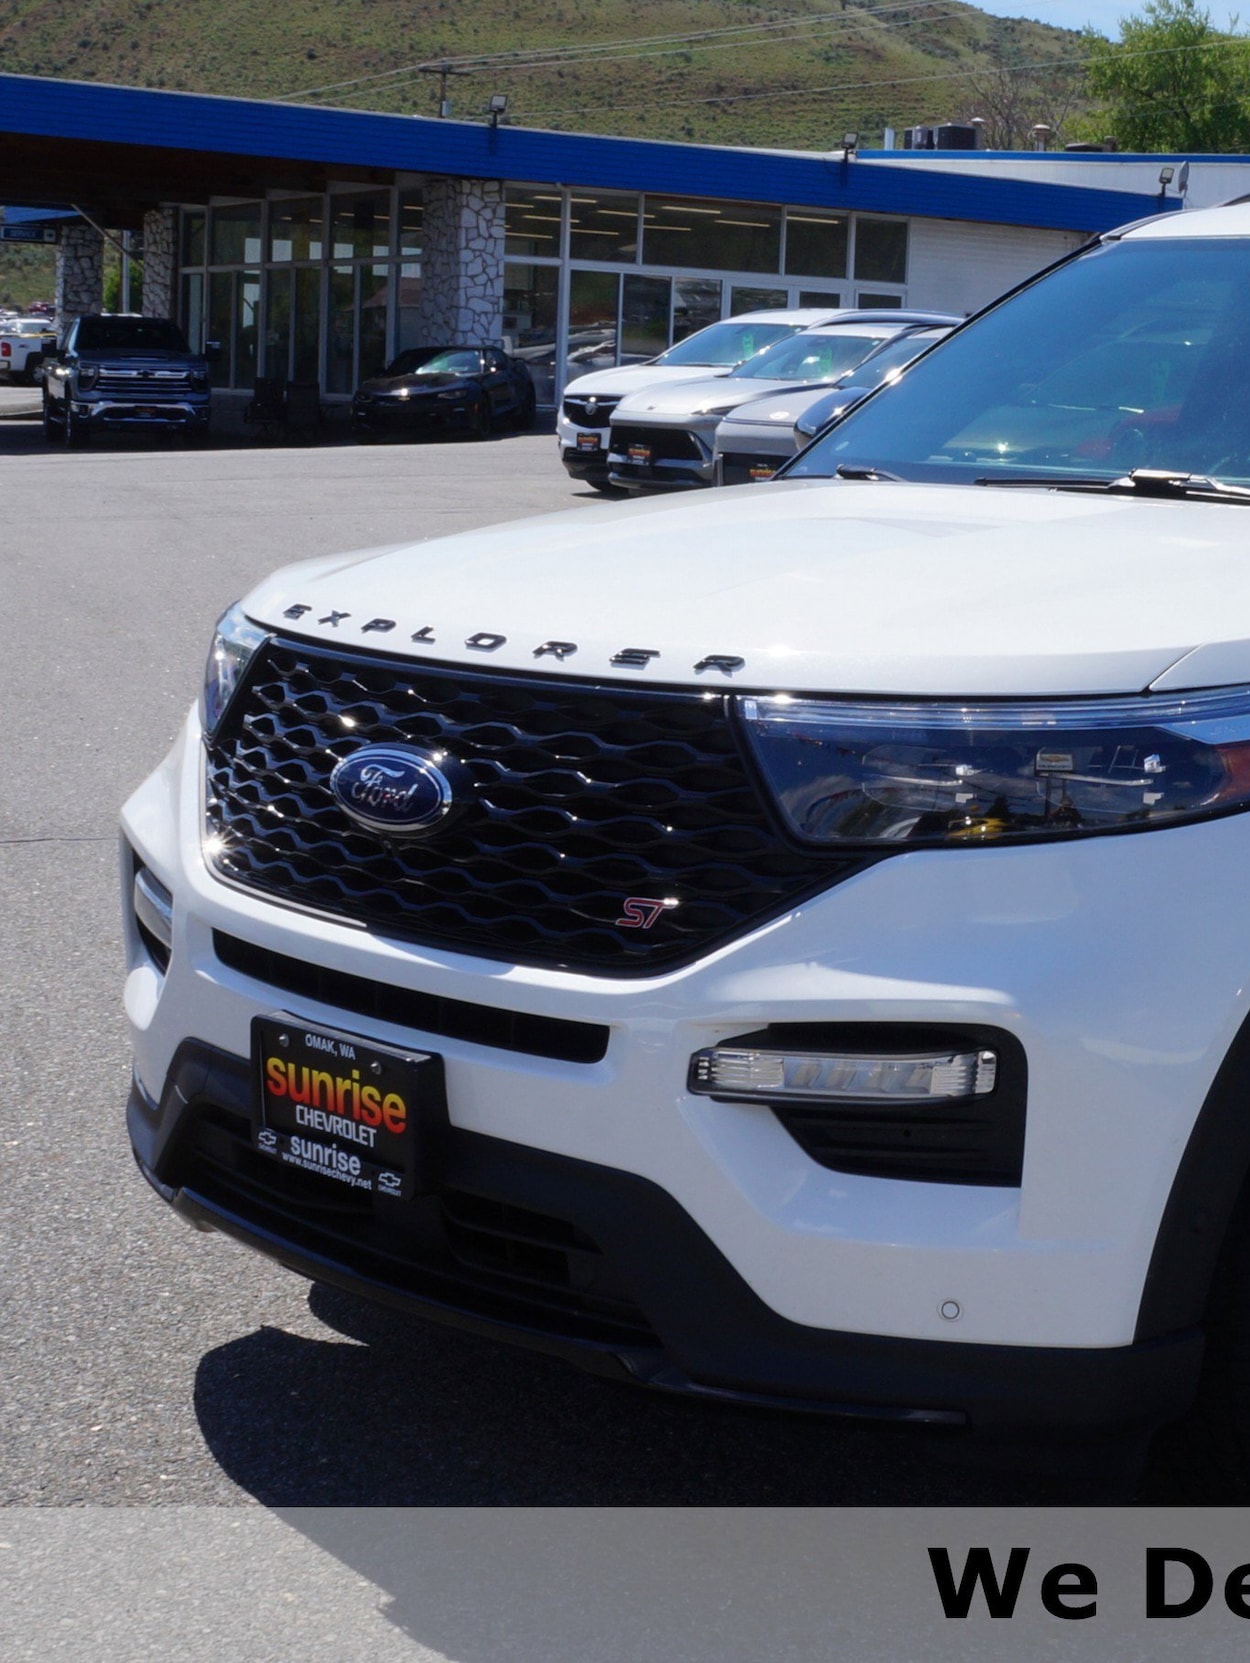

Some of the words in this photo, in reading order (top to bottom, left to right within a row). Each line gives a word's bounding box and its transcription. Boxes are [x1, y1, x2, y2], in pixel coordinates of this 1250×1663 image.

[282, 603, 747, 677] EXPLORER
[350, 763, 418, 812] Ford
[615, 897, 680, 929] ST
[305, 1033, 338, 1057] OMAK,
[339, 1041, 356, 1060] WA
[265, 1056, 407, 1134] sunrise
[295, 1105, 377, 1148] CHEVROLET
[282, 1152, 373, 1190] www.sunrisechevy.net
[290, 1136, 361, 1176] sunrise
